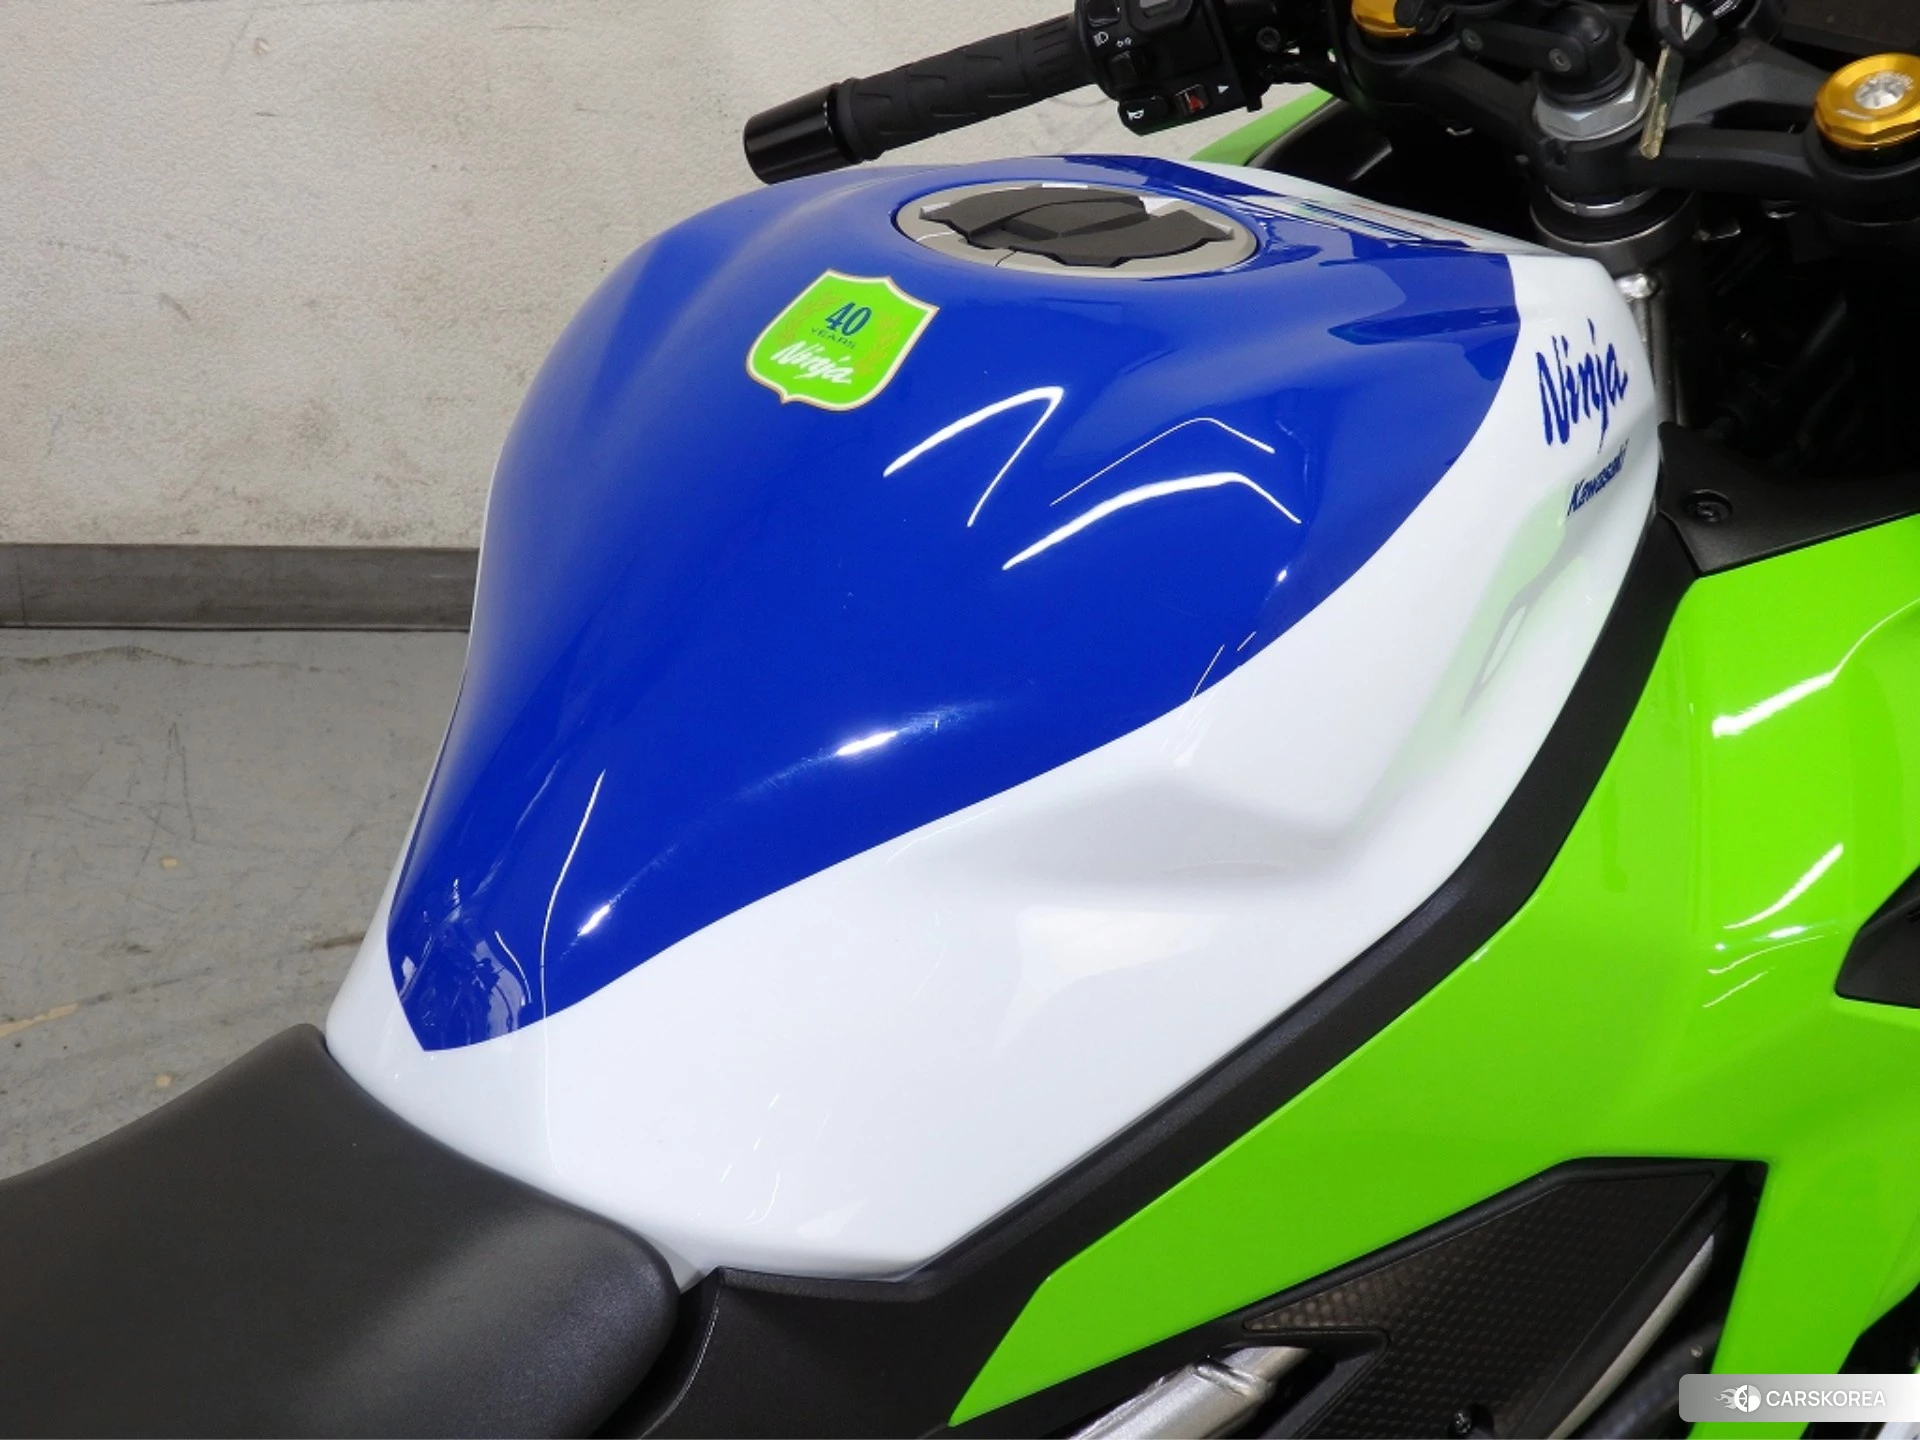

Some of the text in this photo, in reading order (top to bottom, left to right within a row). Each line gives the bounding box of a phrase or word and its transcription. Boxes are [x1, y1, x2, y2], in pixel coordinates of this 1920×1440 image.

[811, 327, 857, 350] YEARS
[825, 302, 872, 336] 40
[770, 340, 854, 384] Ninja
[1536, 318, 1629, 454] Ninja
[1567, 437, 1630, 516] Kawasaki
